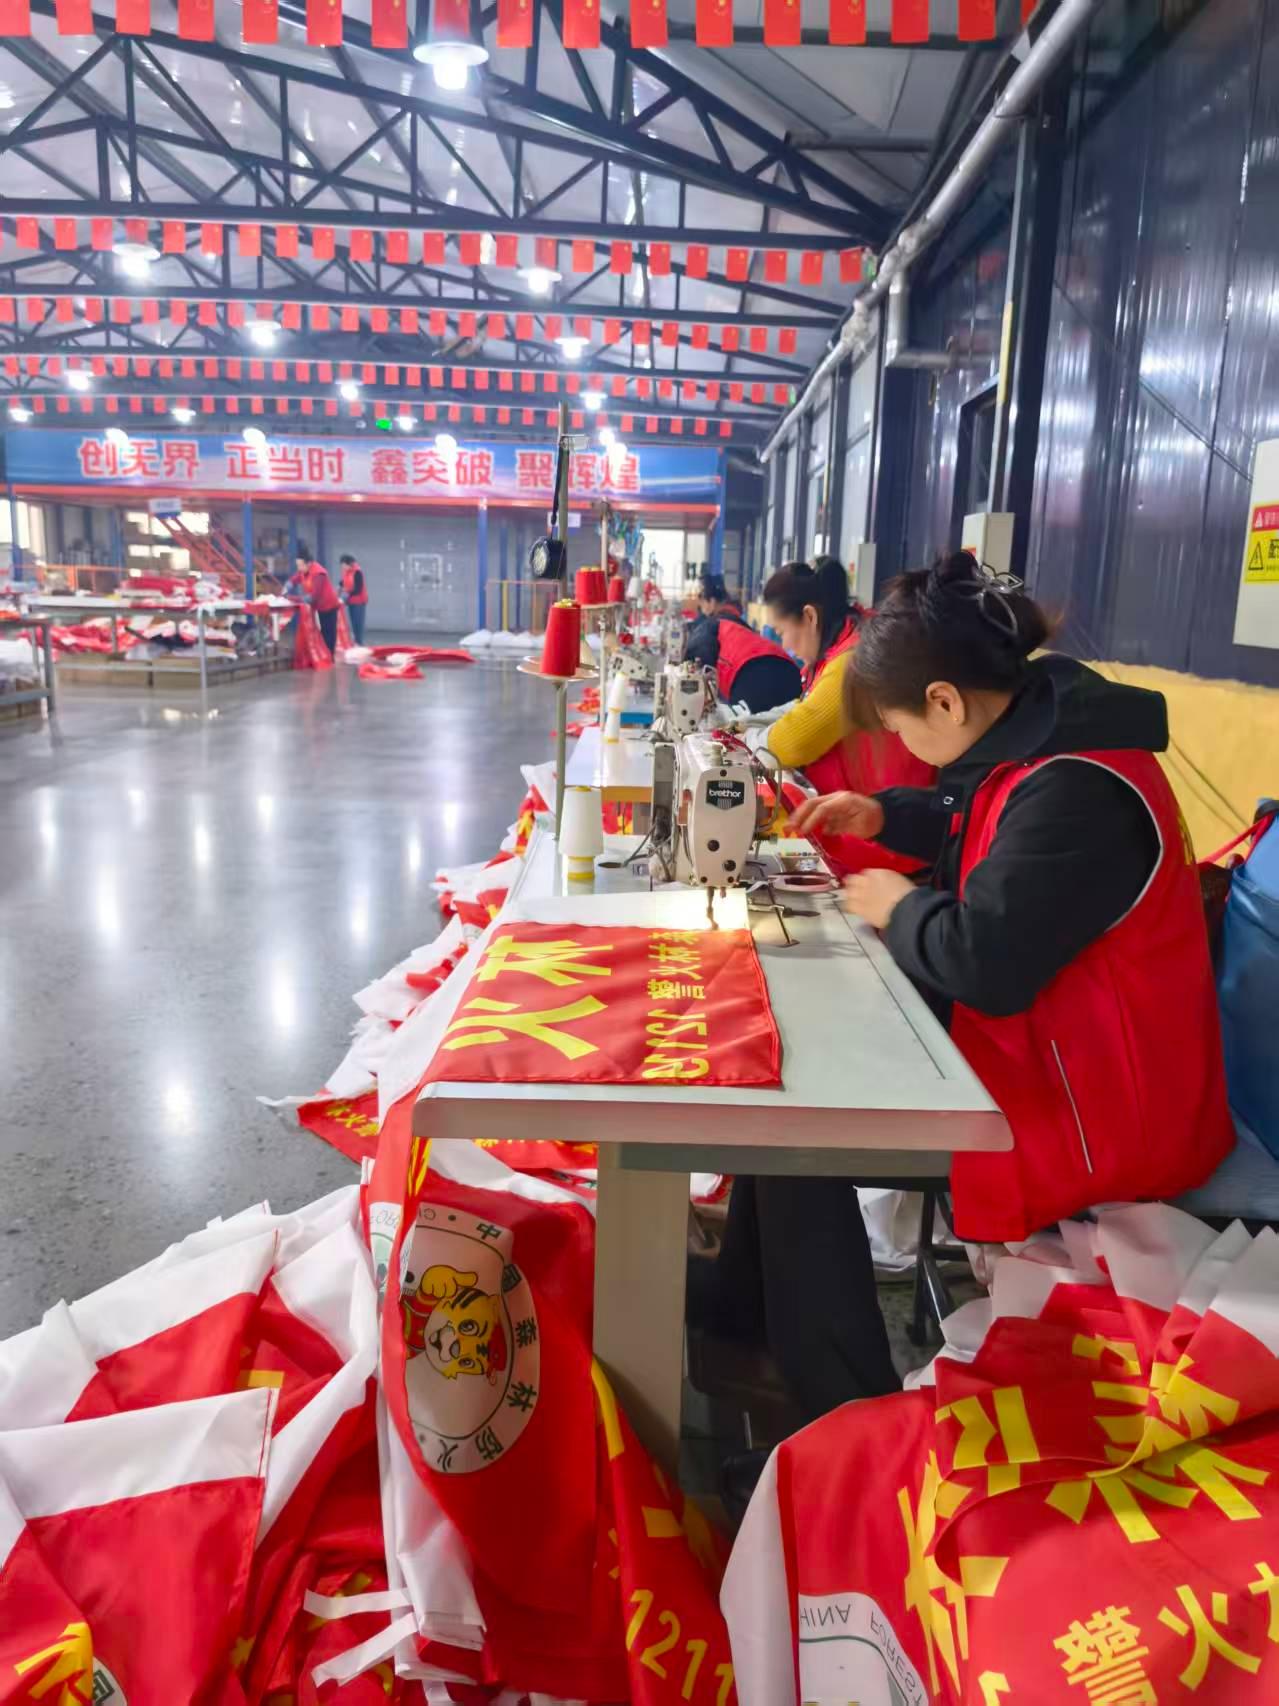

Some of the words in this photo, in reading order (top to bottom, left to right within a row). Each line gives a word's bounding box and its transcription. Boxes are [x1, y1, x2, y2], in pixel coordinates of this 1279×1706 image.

[80, 439, 199, 479] 创无界
[225, 443, 345, 483] 正当时
[371, 448, 493, 485] 鑫突破
[517, 451, 640, 491] 聚辉煌
